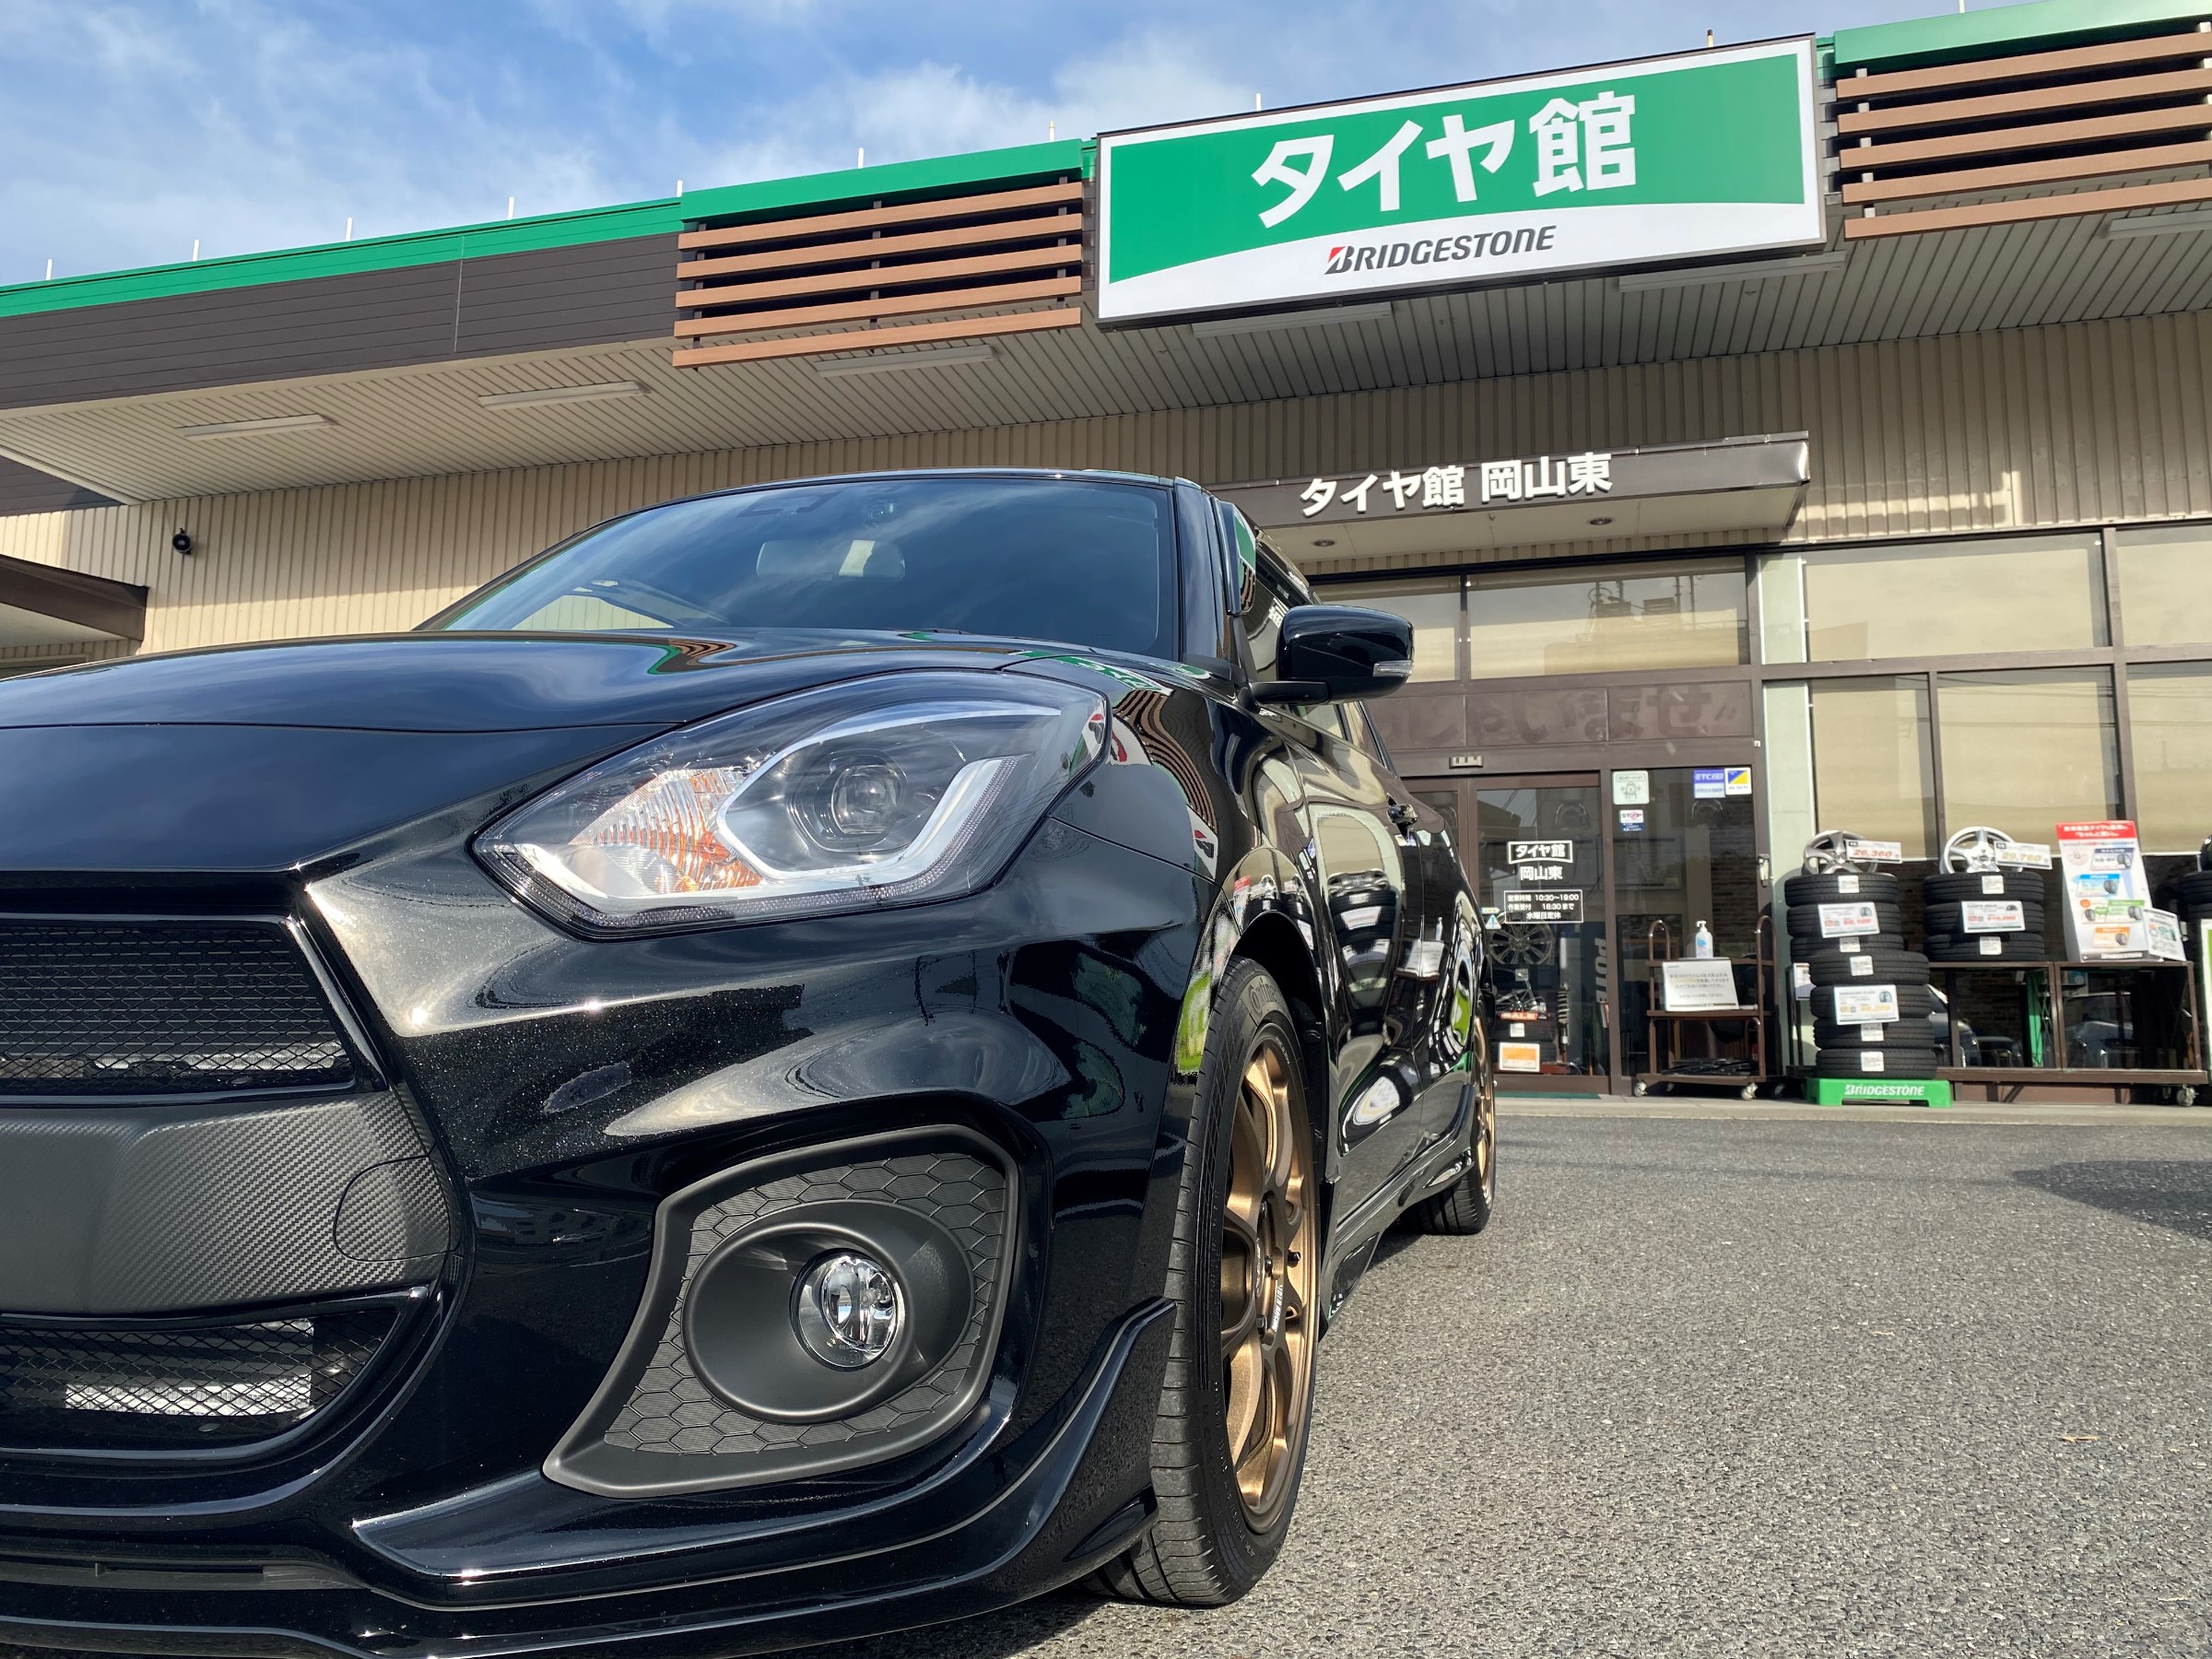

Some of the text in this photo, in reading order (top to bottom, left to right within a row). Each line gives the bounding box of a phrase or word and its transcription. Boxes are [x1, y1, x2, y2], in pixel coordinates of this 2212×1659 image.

[1252, 90, 1636, 229] タイヤ館
[1324, 225, 1557, 276] BRIDGESTONE
[1300, 452, 1613, 517] タイヤ館 岡山東
[1516, 844, 1566, 858] タイヤ館
[1520, 865, 1563, 881] 岡山東
[1844, 1084, 1925, 1096] BRIDGESTONE
